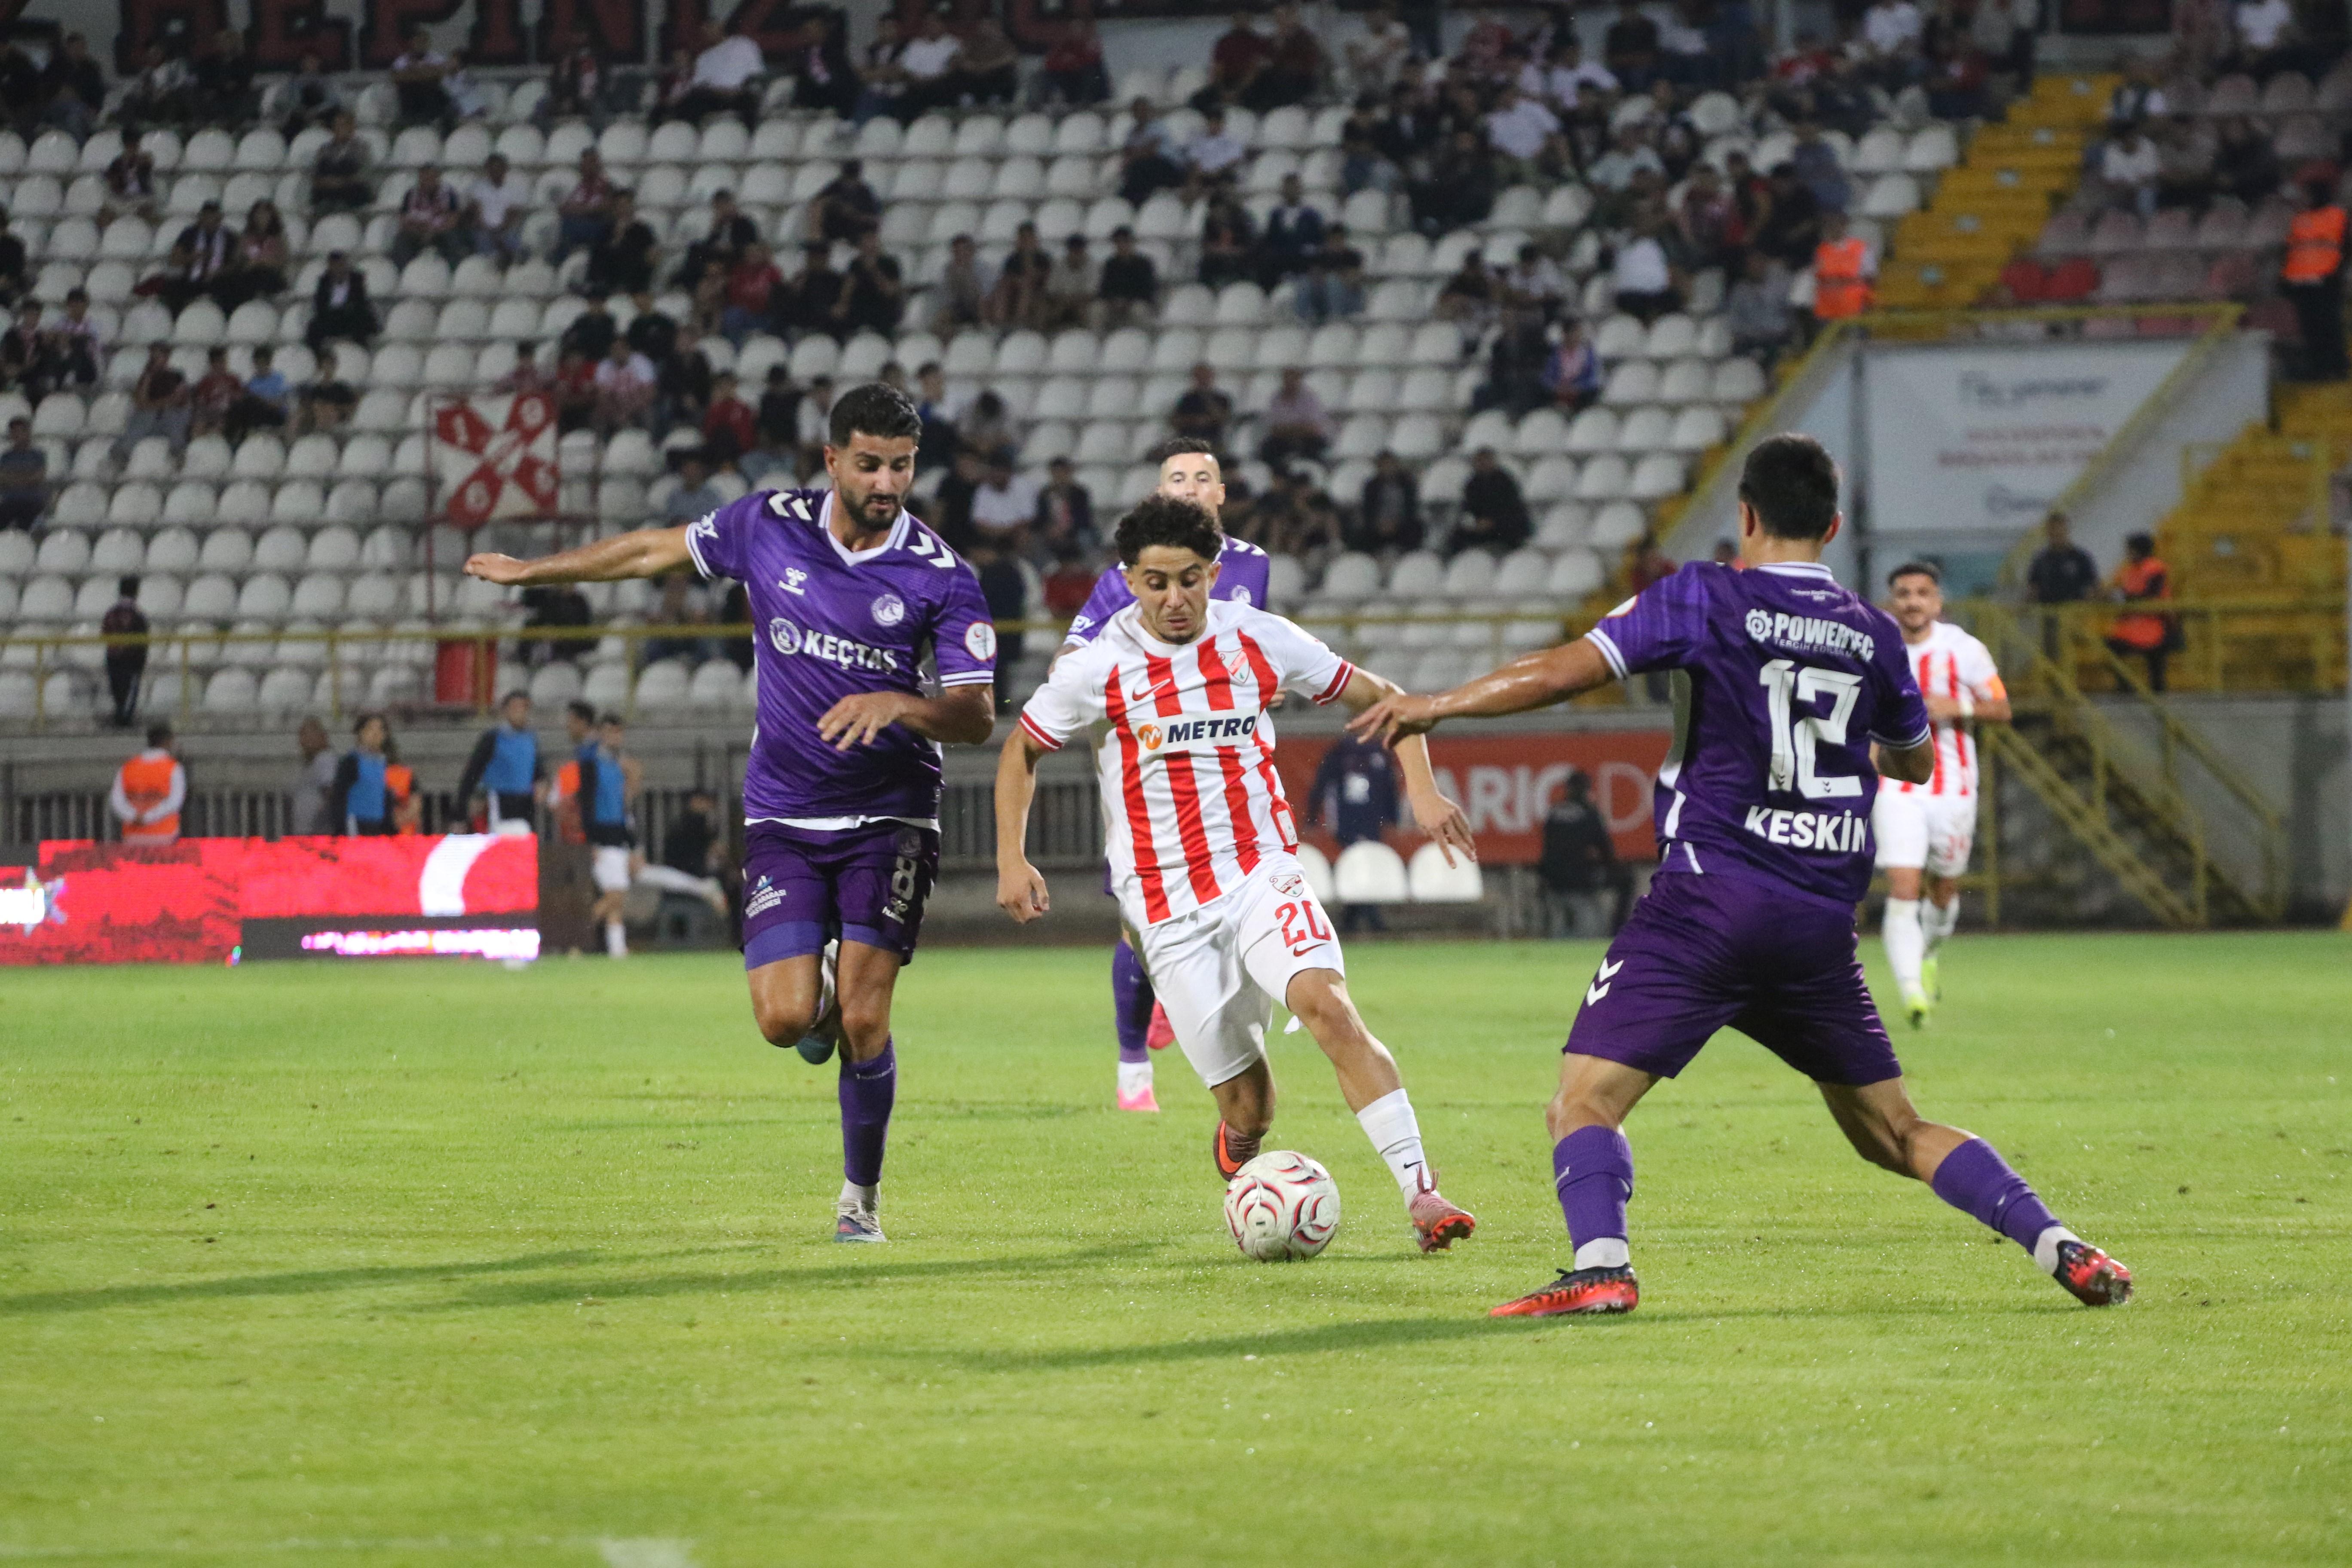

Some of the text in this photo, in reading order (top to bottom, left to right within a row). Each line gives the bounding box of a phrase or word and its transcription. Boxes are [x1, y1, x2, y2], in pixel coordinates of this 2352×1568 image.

[804, 629, 898, 675] KEÇTAŞ
[1167, 716, 1256, 743] METRO
[1759, 658, 1863, 799] 12
[1745, 805, 1868, 853] KESKİN
[891, 855, 917, 900] 8
[1275, 900, 1332, 948] 20
